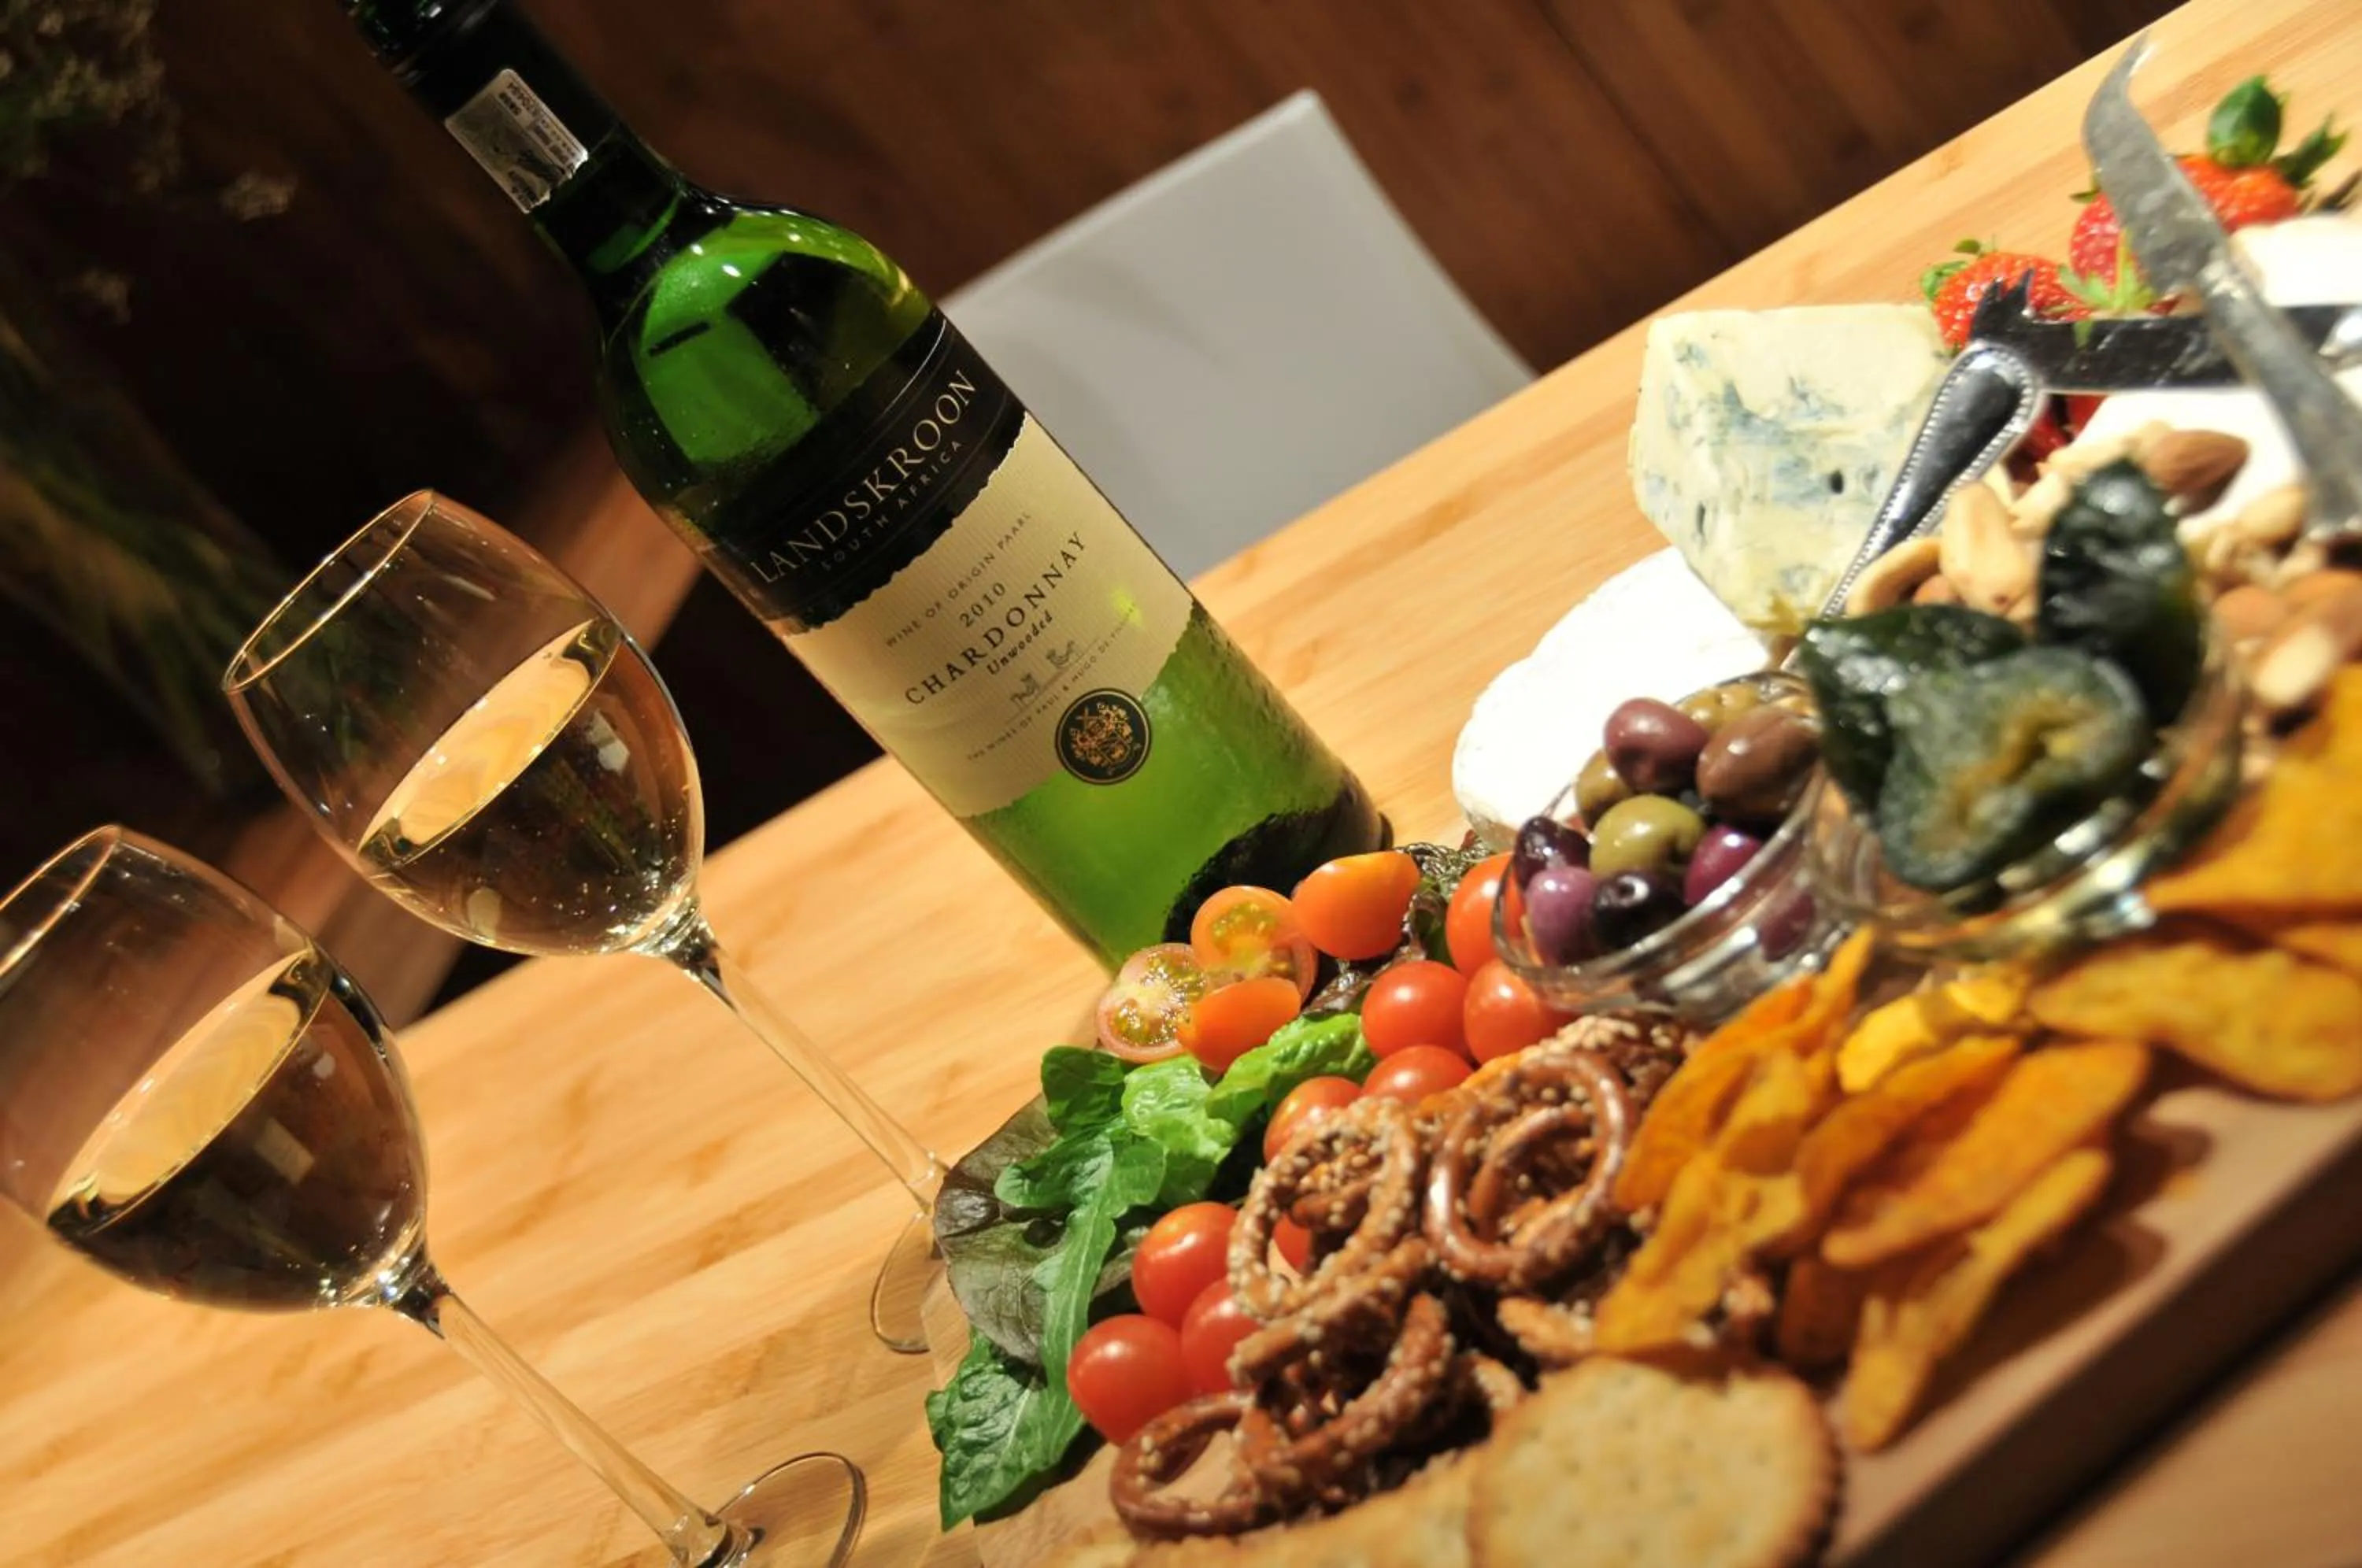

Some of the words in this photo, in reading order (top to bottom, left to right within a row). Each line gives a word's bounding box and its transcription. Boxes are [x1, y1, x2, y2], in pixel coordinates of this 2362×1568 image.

[750, 369, 976, 583] LANDSKROON
[821, 515, 889, 571] SOUTH
[898, 441, 961, 510] AFRICA
[886, 620, 921, 647] WINE
[925, 601, 942, 619] OF
[948, 553, 995, 600] ORIGIN
[998, 512, 1031, 550] PAARL
[905, 531, 1085, 704] CHARDONNAY
[960, 582, 1005, 628] 2010
[987, 609, 1053, 675] Unwooded
